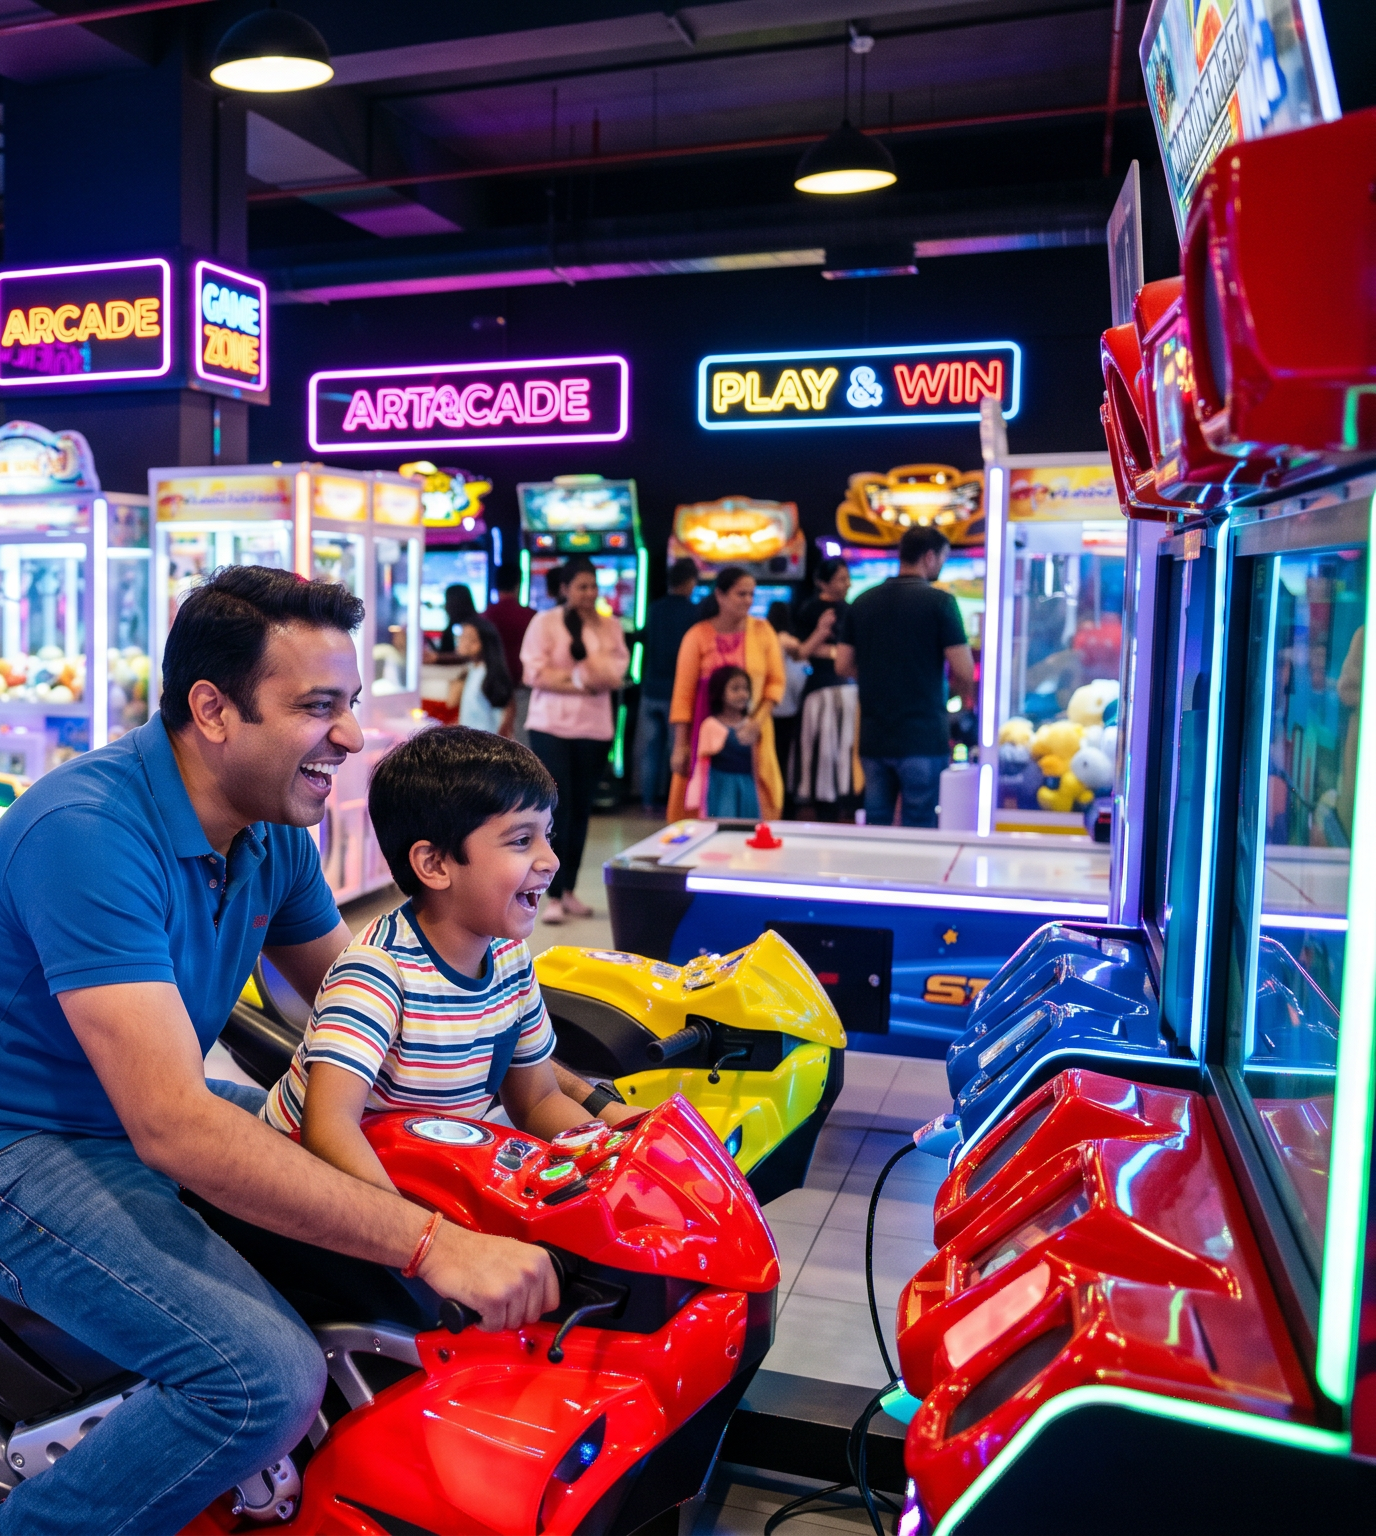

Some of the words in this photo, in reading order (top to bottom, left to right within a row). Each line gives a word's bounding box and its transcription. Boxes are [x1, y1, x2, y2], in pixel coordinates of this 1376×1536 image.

[0, 297, 161, 347] ARCADE
[201, 282, 260, 337] GAME
[203, 323, 260, 375] ZONE
[713, 367, 839, 413] PLAY
[846, 365, 883, 409] &
[894, 360, 1003, 406] WIN
